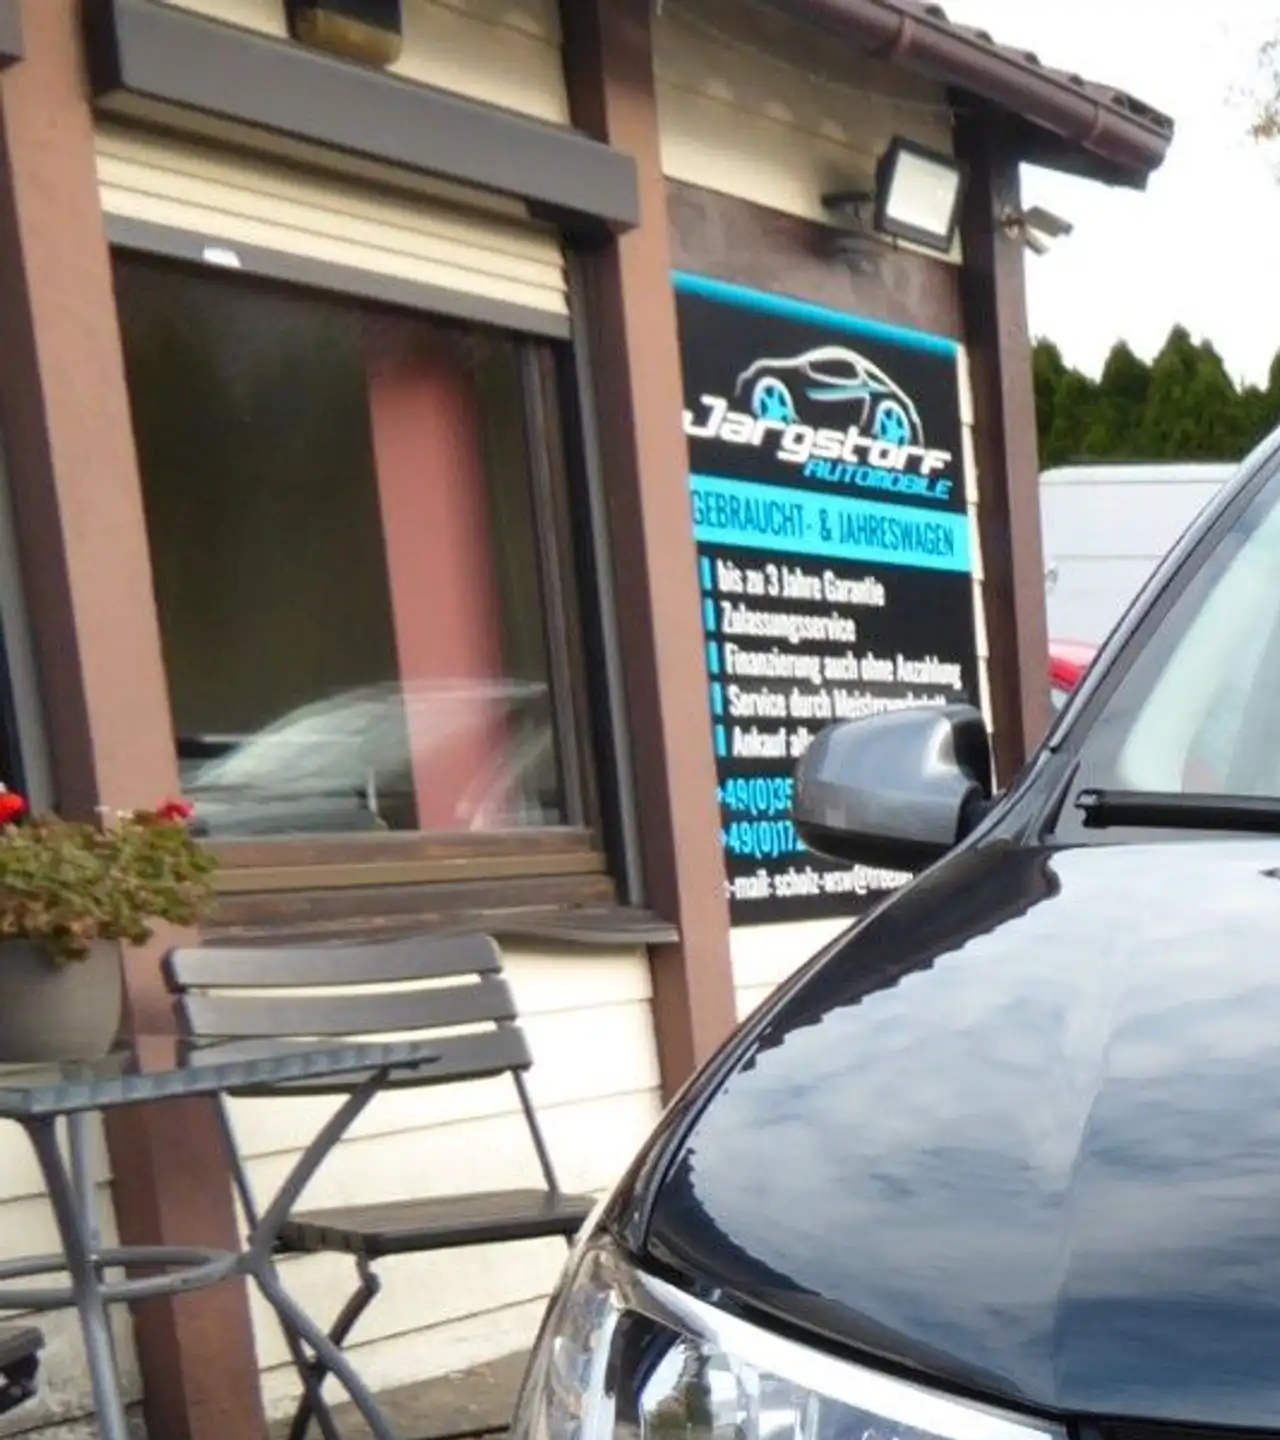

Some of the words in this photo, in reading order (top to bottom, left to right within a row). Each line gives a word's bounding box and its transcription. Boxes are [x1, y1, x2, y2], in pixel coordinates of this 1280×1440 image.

[682, 394, 951, 474] Jargstorf
[803, 459, 953, 500] AUTOMOBILE
[692, 489, 812, 538] GEBRAUCHT-
[819, 508, 832, 542] &
[838, 511, 955, 557] JAHRESWAGEN
[716, 558, 743, 593] bis
[766, 563, 779, 597] 3
[780, 565, 822, 601] Jahre
[823, 569, 885, 607] Garantie
[720, 600, 857, 645] Zulassungsservice
[724, 642, 822, 685] Finanzierung
[823, 650, 858, 680] auch
[860, 651, 895, 682] ohne
[896, 653, 962, 690] Anzahlung
[727, 684, 787, 718] Service
[788, 686, 832, 718] durch
[732, 725, 787, 758] Ankauf
